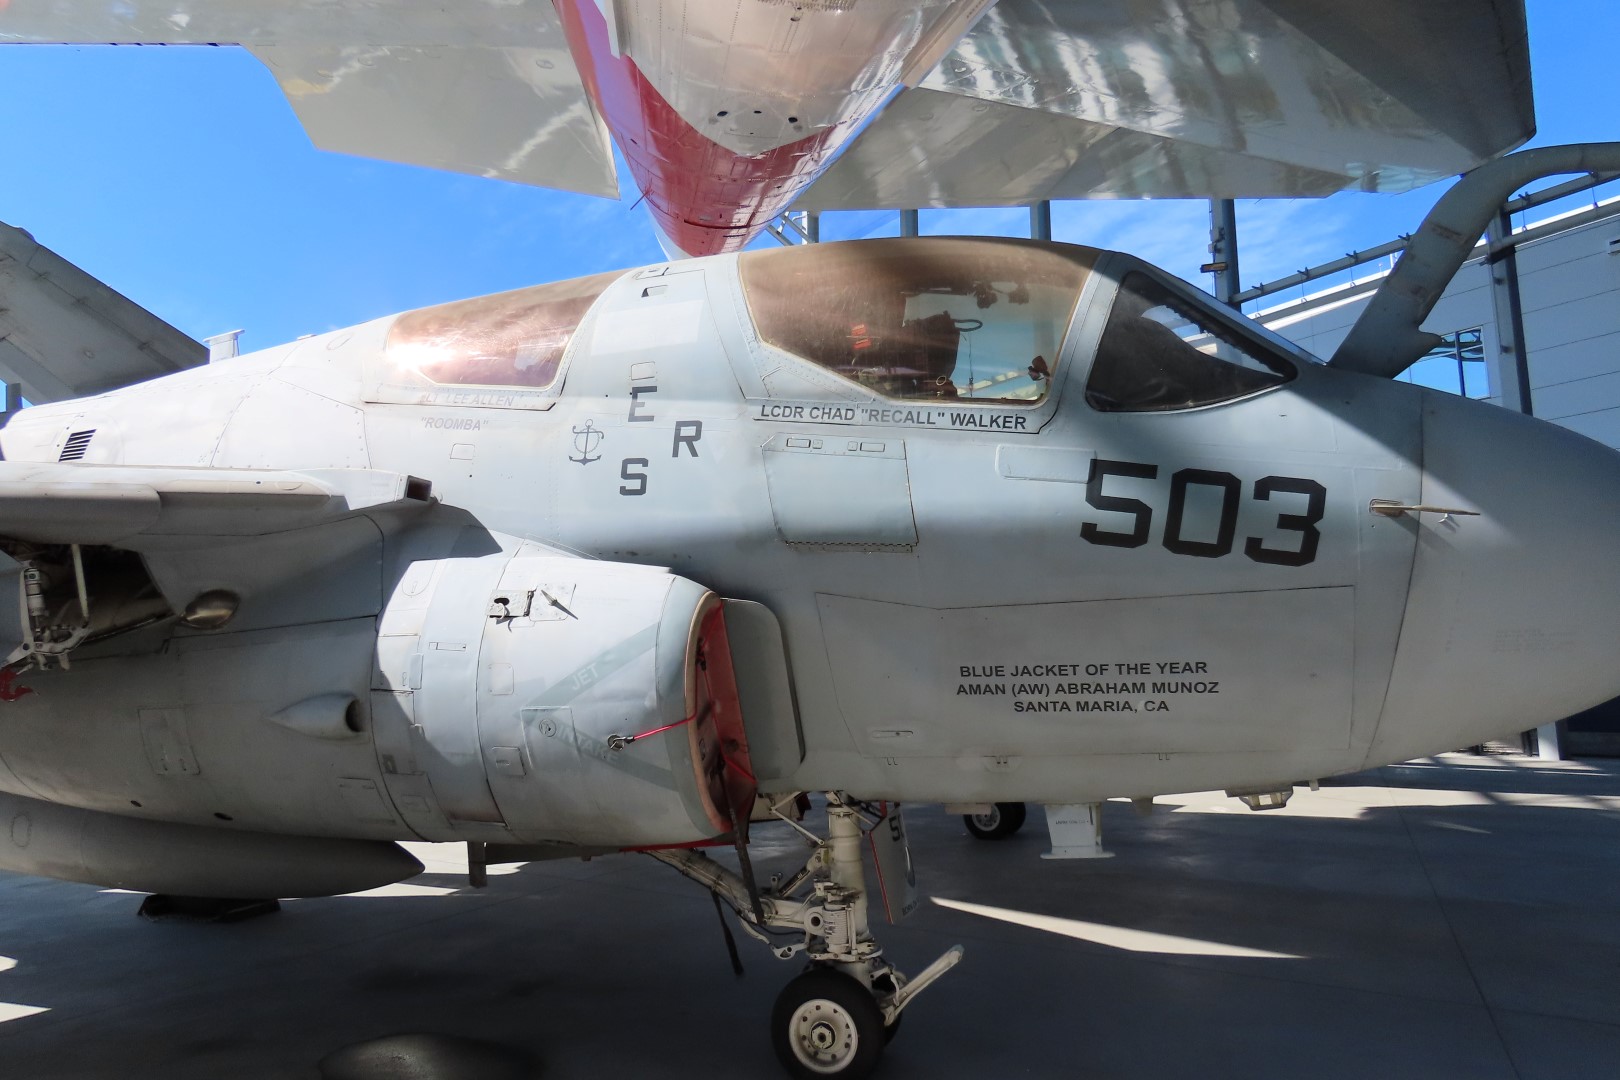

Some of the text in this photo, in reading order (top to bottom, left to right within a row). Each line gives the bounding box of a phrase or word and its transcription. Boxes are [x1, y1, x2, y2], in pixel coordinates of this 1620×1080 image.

[469, 394, 514, 407] ALLEN
[628, 386, 658, 423] E
[421, 417, 489, 431] "ROOMBA"
[761, 404, 1027, 430] LCDR CHAD "RECALL" WALKER
[672, 420, 703, 458] R
[619, 457, 649, 496] S
[1080, 458, 1327, 567] 503
[572, 662, 599, 690] JET
[960, 661, 1208, 677] BLUE JACKET OF THE YEAR
[956, 681, 1220, 698] AMAN (AW) ABRAHAM MUNOZ
[1014, 700, 1170, 714] SANTA MARIA, CA
